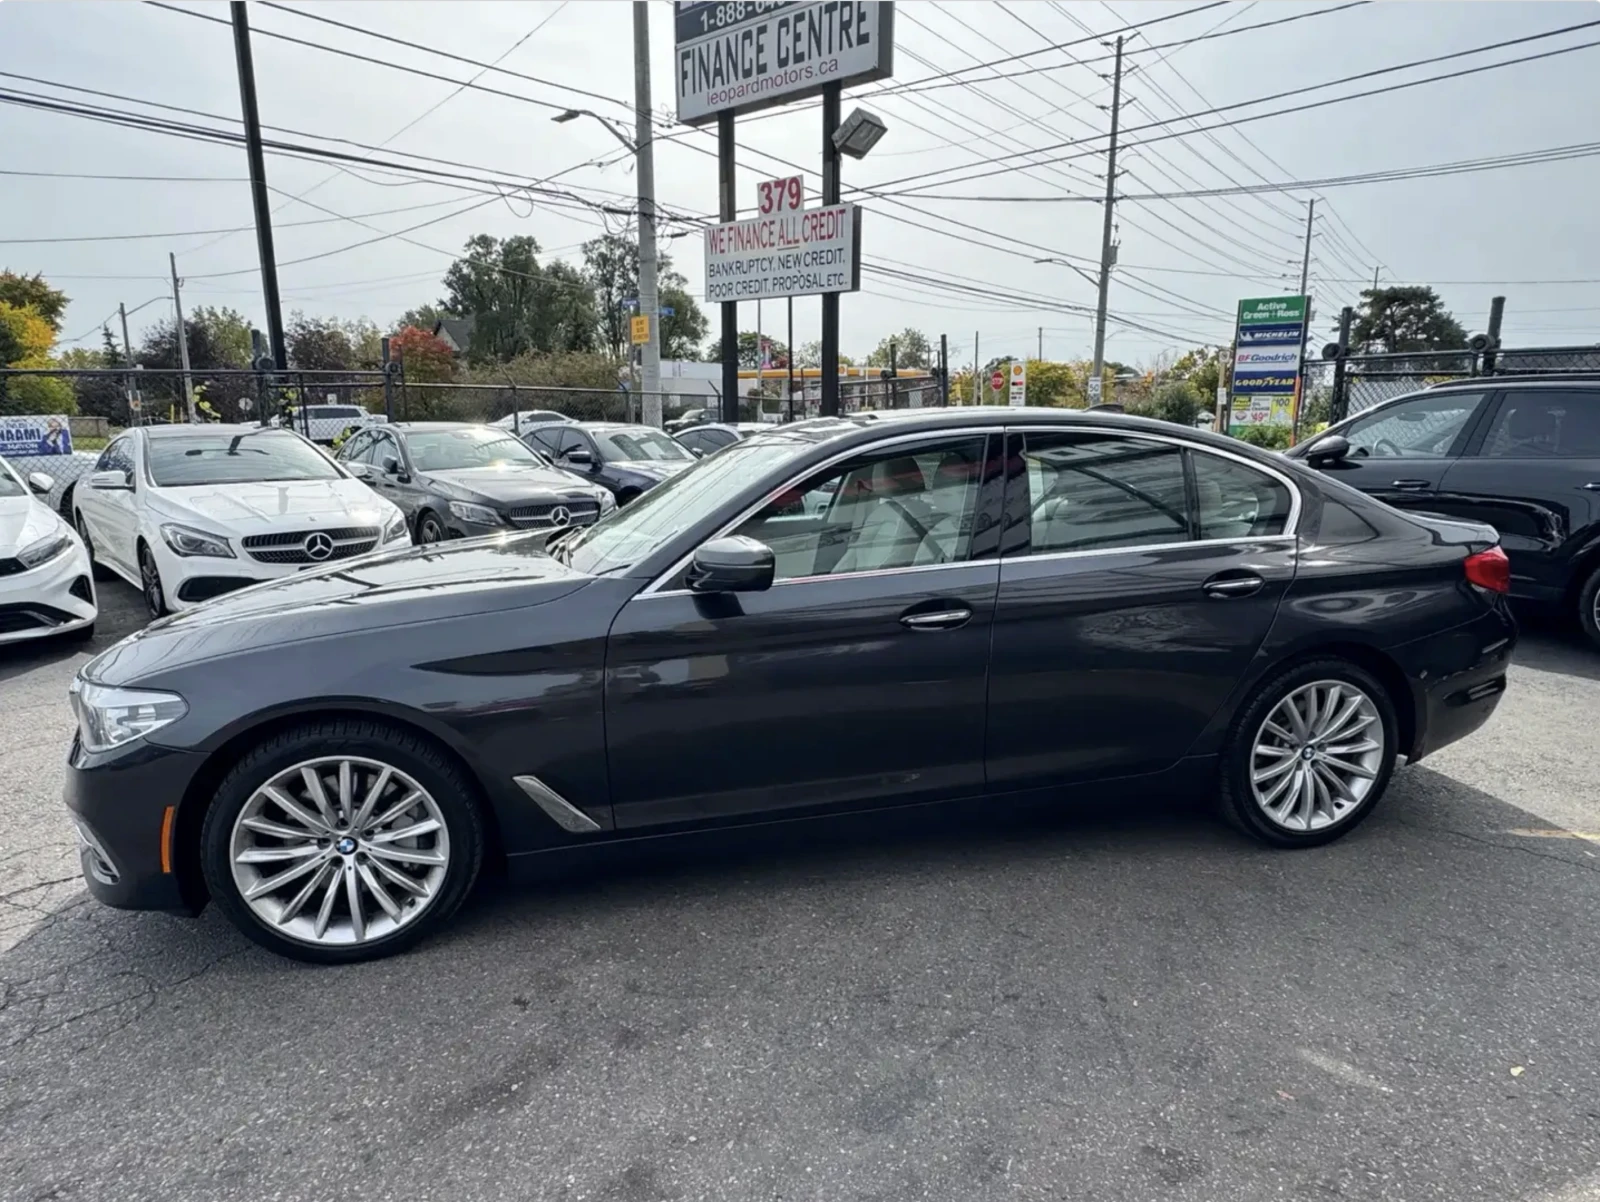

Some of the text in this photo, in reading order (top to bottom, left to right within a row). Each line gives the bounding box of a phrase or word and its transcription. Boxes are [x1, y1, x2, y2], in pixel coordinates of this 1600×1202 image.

[681, 1, 870, 97] FINANCE CENTRE
[706, 58, 839, 107] leopardmotors.ca
[760, 177, 801, 214] 379
[709, 209, 846, 255] WE FINANCE ALL CREDIT
[778, 253, 801, 271] NEW
[709, 283, 734, 298] POOR
[772, 273, 825, 292] PROPOSAL
[827, 273, 848, 286] ETC.
[1257, 302, 1287, 310] Active
[1235, 377, 1295, 387] GOODYEAR
